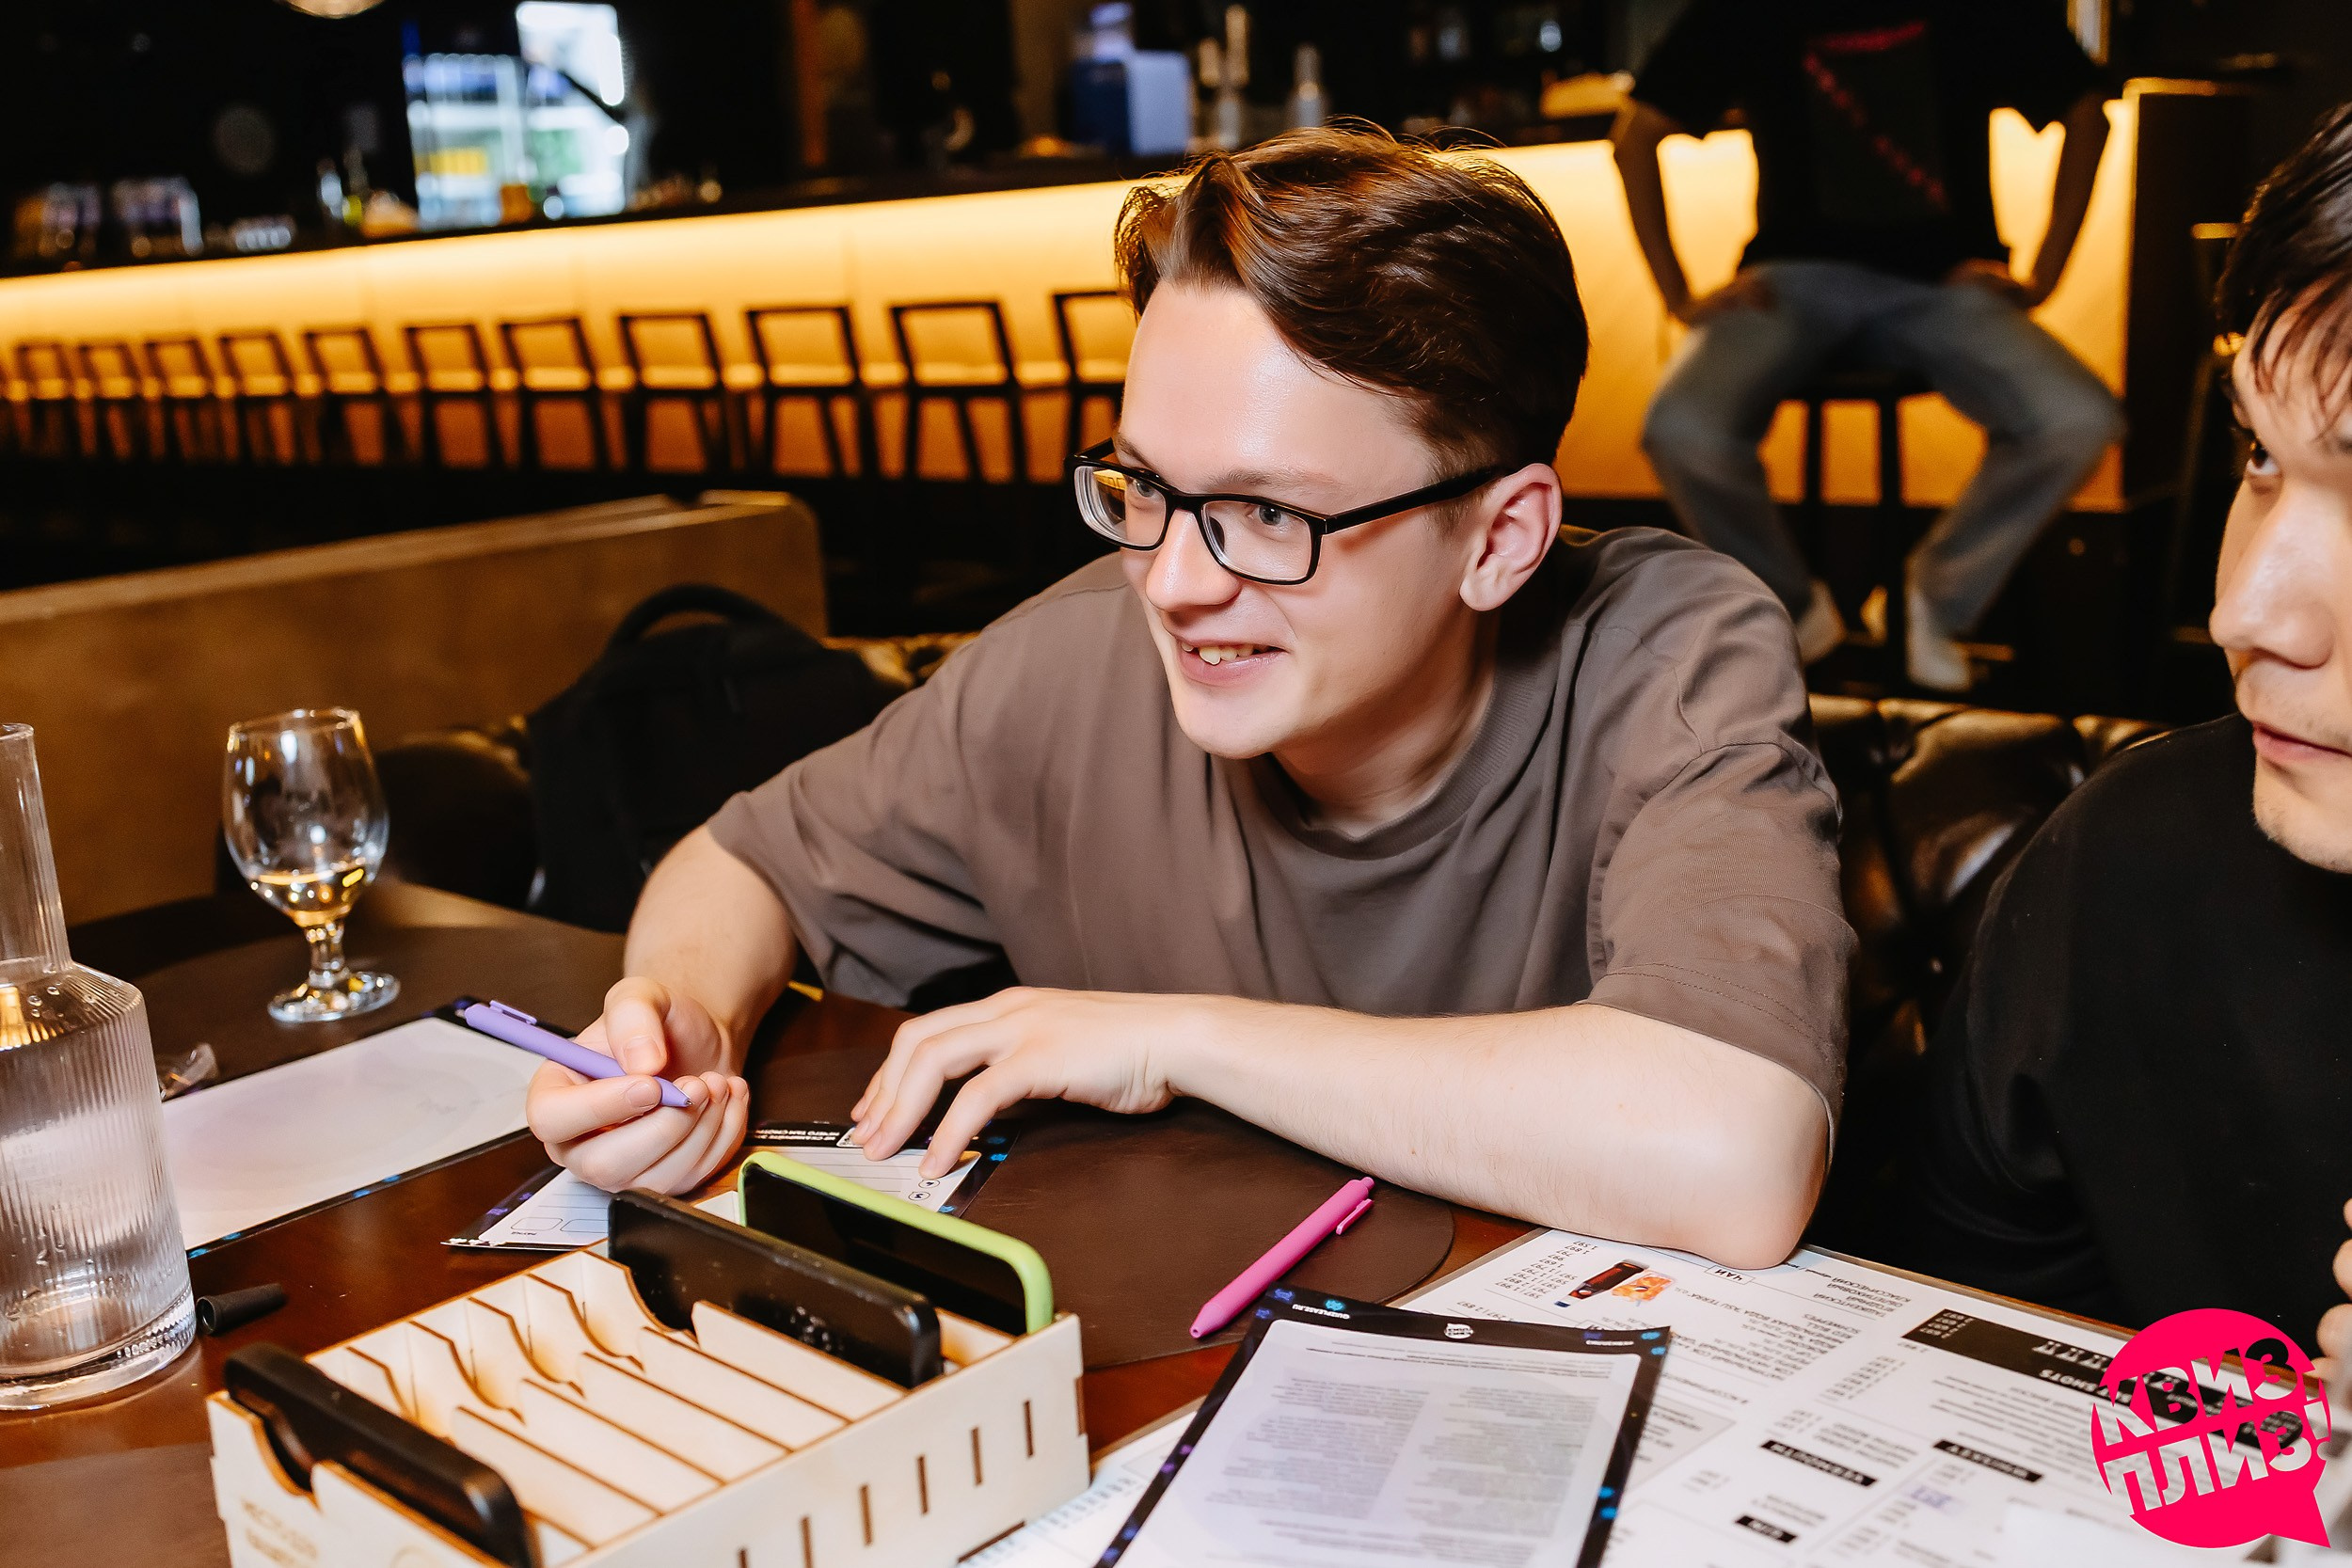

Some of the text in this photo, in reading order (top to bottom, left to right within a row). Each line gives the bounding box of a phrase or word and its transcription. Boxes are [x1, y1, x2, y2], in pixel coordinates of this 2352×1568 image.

[1827, 1283, 1902, 1307] ОБЛЕПИХОВЫЙ
[1832, 1277, 1911, 1303] КЛАССИЧЕСКИЙ
[1292, 1303, 1350, 1320] QUIZPLEASE.RU
[1813, 1292, 1886, 1318] ТАШКЕНТСКИЙ
[1846, 1295, 1896, 1312] ЯГОДНЫЙ
[2039, 1369, 2099, 1393] SHOTS
